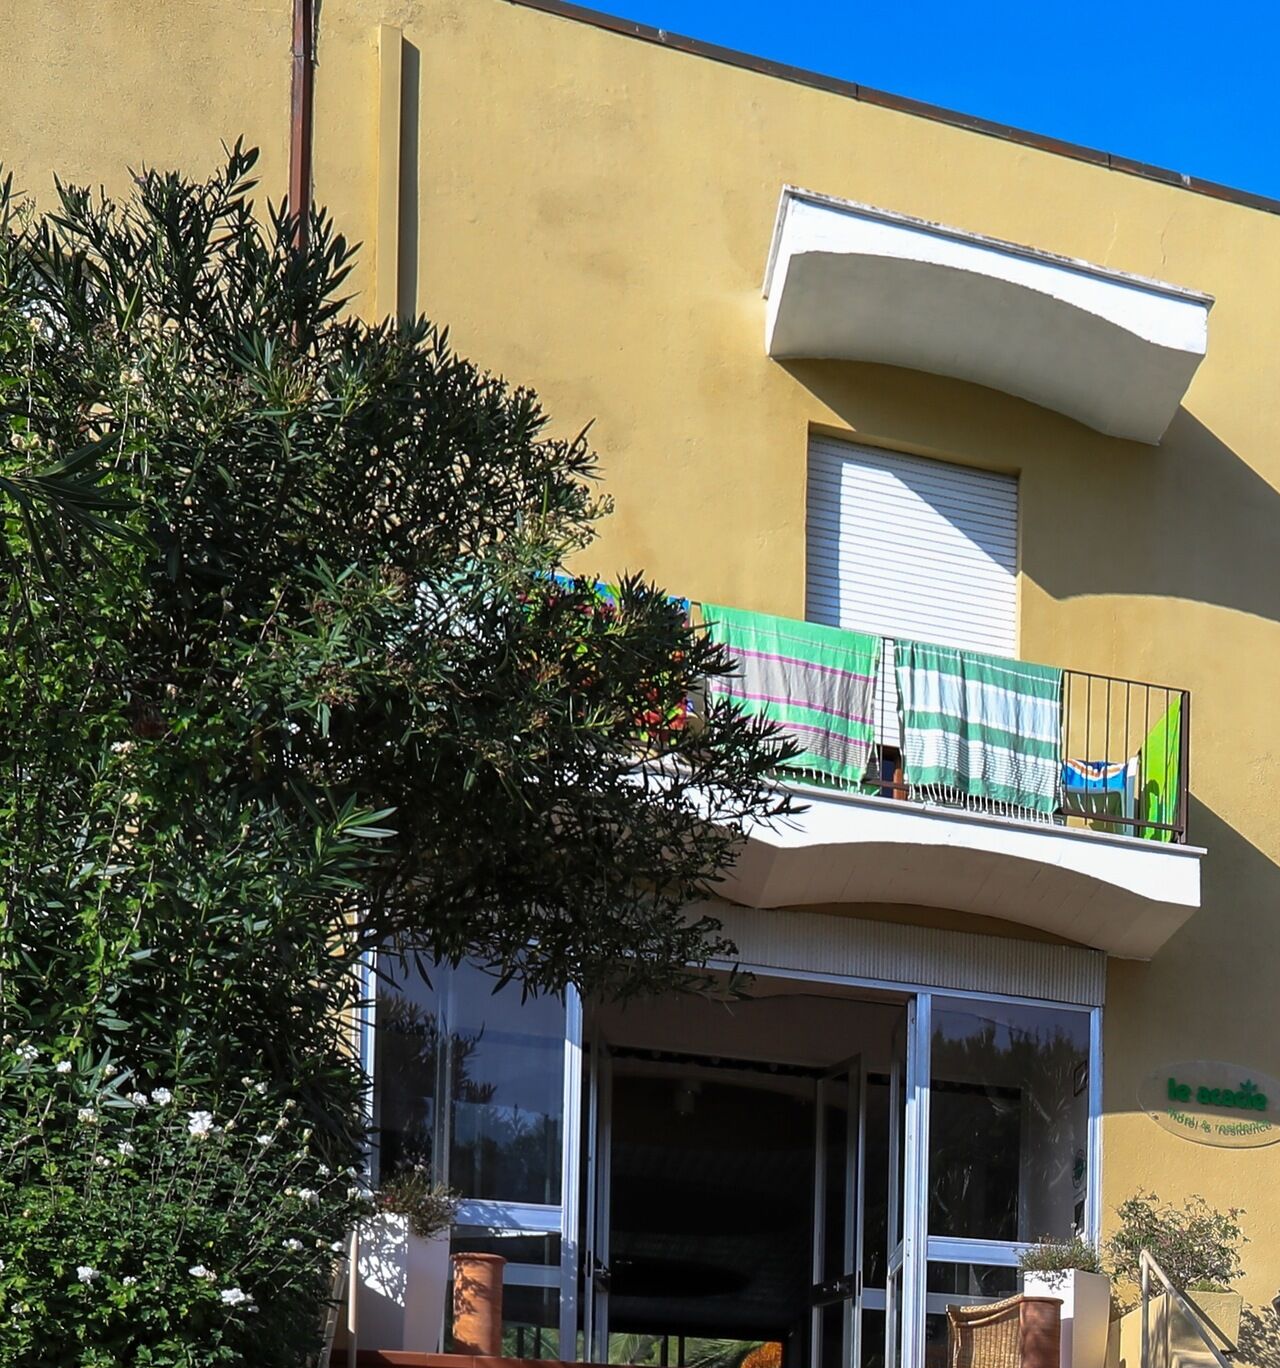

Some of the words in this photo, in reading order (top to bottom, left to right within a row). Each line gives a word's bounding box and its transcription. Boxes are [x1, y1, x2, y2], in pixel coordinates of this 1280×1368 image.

[1168, 1078, 1191, 1102] le
[1197, 1086, 1268, 1111] acacie
[1215, 1120, 1272, 1136] residence
